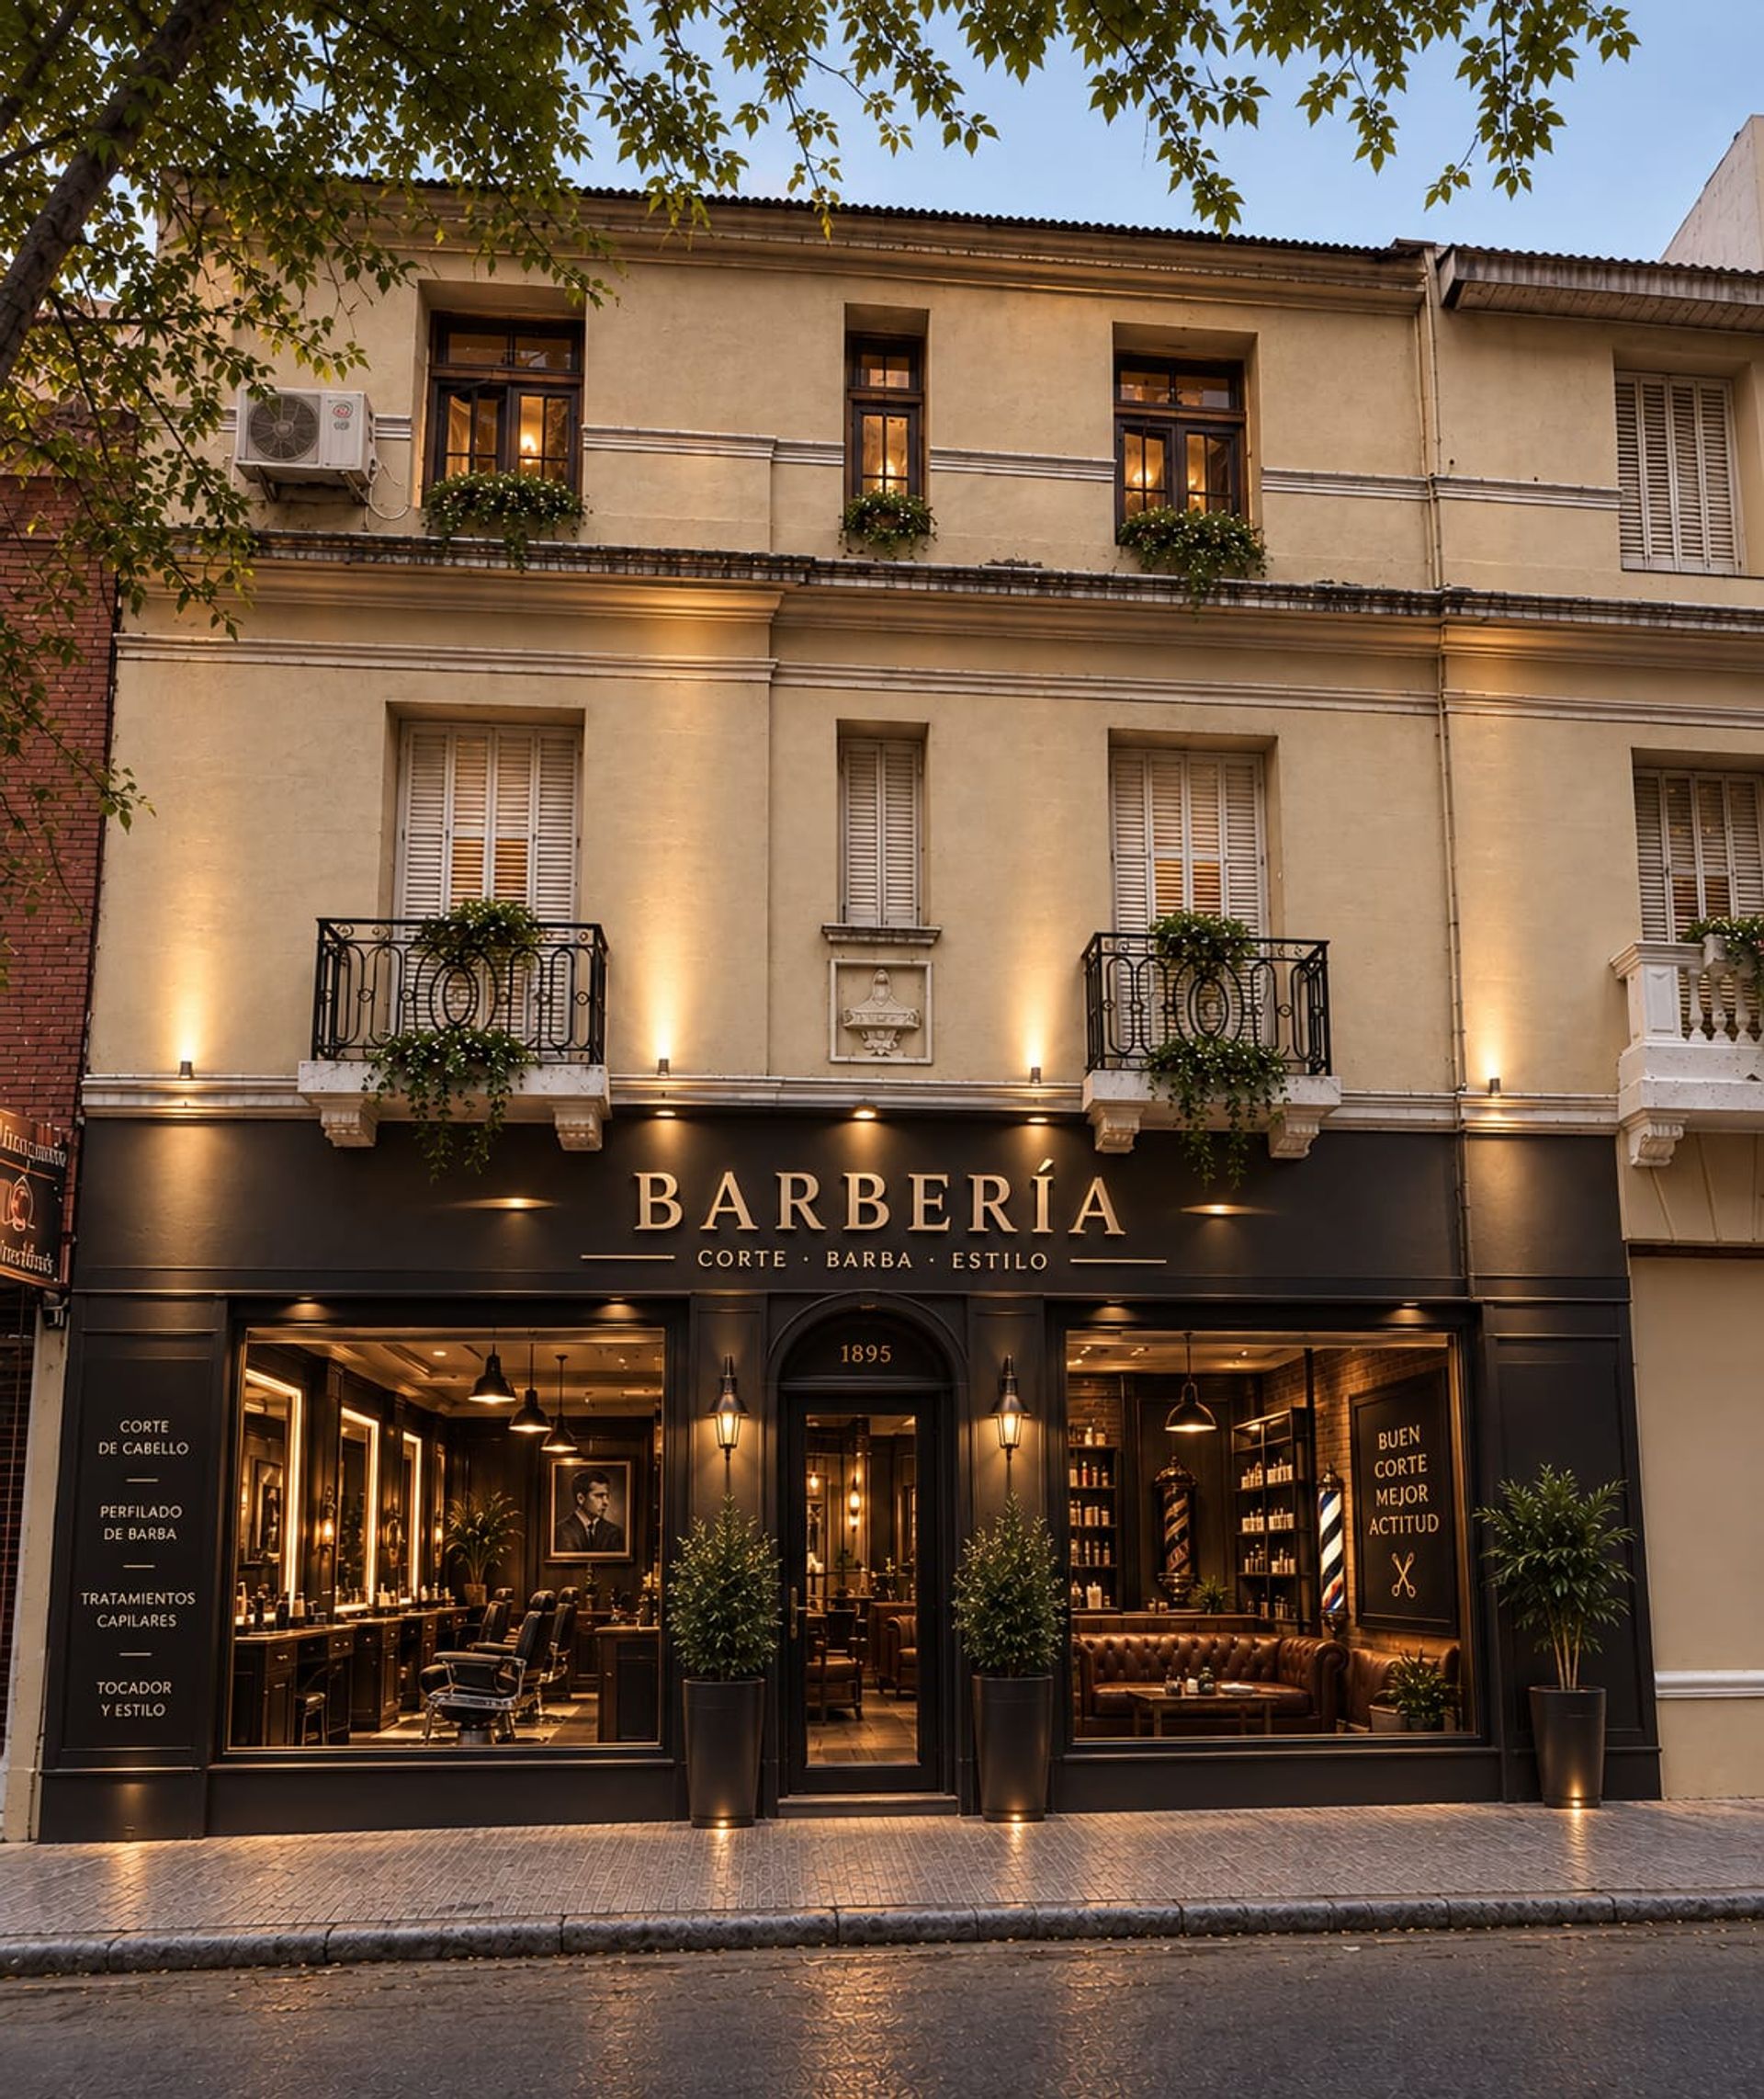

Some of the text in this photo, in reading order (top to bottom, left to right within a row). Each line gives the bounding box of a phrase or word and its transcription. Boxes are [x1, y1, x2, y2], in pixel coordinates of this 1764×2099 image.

[635, 1159, 1125, 1234] BARBERÍA
[698, 1251, 1046, 1269] CORTE BARBA ESTILO
[843, 1345, 890, 1362] 1895
[120, 1421, 168, 1433] CORTE
[1379, 1425, 1419, 1449] BUEN
[99, 1442, 188, 1454] DE CABELLO
[1374, 1454, 1426, 1478] CORTE
[1376, 1484, 1428, 1506] MEJOR
[101, 1506, 182, 1518] PERFILADO
[1370, 1515, 1438, 1535] ACTITUD
[105, 1528, 176, 1539] DE BARBA
[82, 1593, 195, 1605] TRATAMIENTOS
[97, 1615, 175, 1627] CAPILARES
[97, 1682, 171, 1694] TOCADOR
[102, 1704, 164, 1716] Y ESTILO
